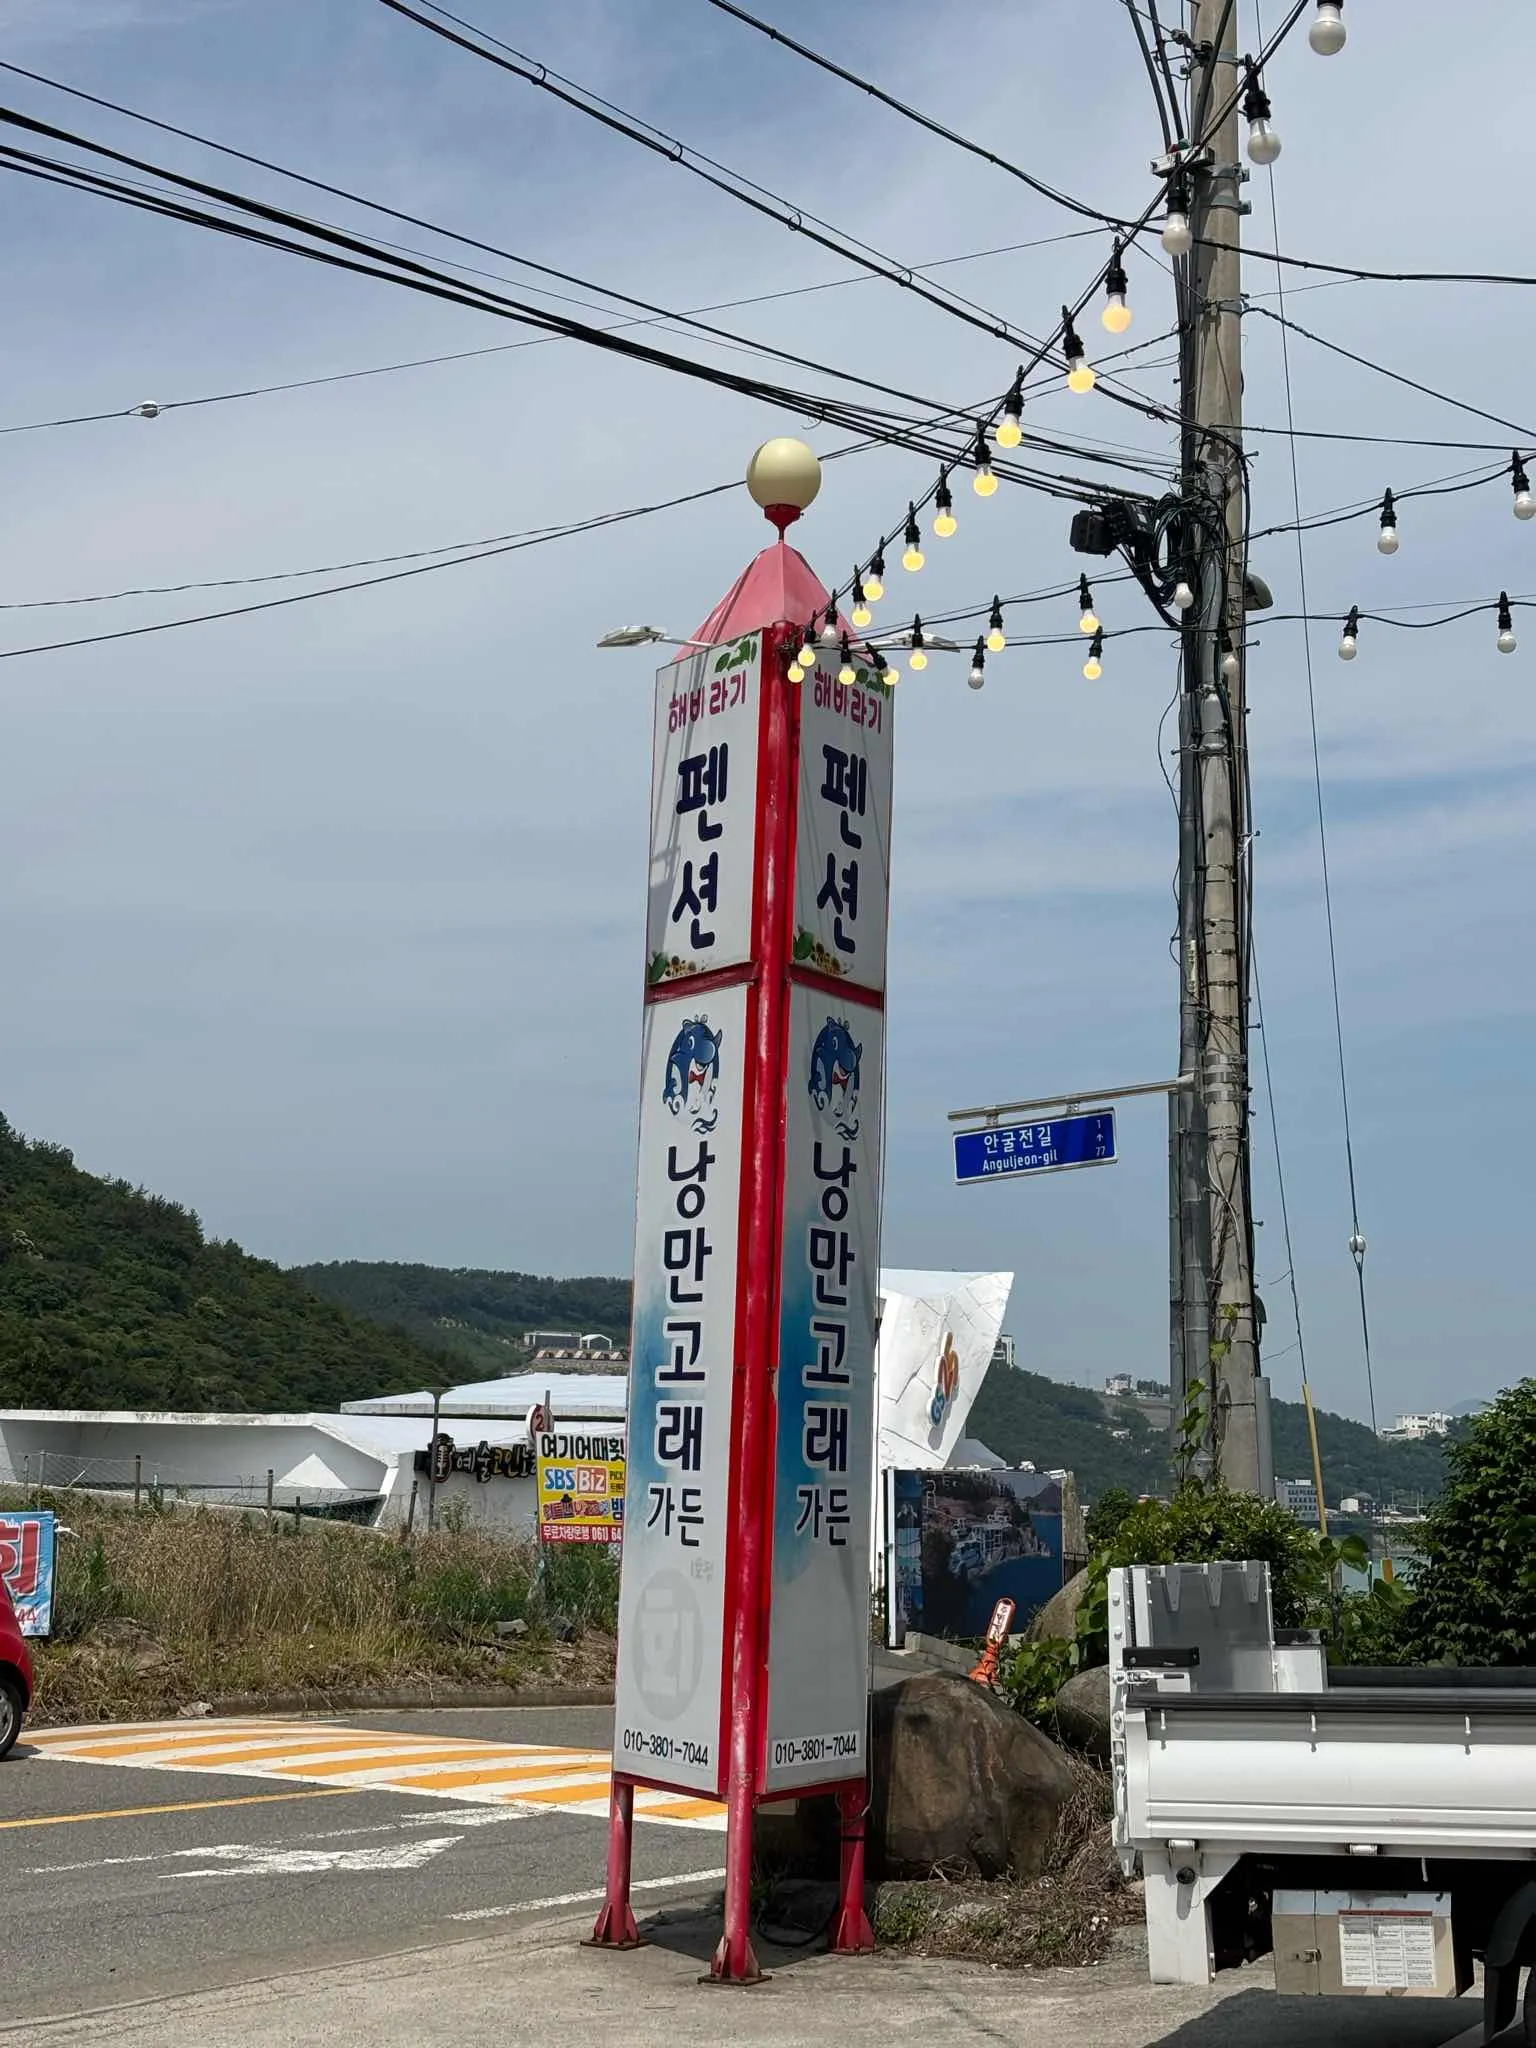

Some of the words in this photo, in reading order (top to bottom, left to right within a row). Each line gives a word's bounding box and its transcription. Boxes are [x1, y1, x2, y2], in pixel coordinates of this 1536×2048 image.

[672, 742, 729, 950] 펜션
[817, 743, 867, 954] 펜션
[982, 1149, 1058, 1173] Anguljeon-gil
[984, 1125, 1051, 1154] 안굴전길
[658, 1140, 715, 1471] 낭만고래
[806, 1140, 857, 1472] 낭만고래
[544, 1468, 576, 1491] SBS
[578, 1468, 606, 1492] Biz
[648, 1487, 704, 1546] 가든
[796, 1488, 850, 1546] 가든
[623, 1729, 709, 1766] 010-3801-7044
[775, 1732, 857, 1764] 010-3801-7044
